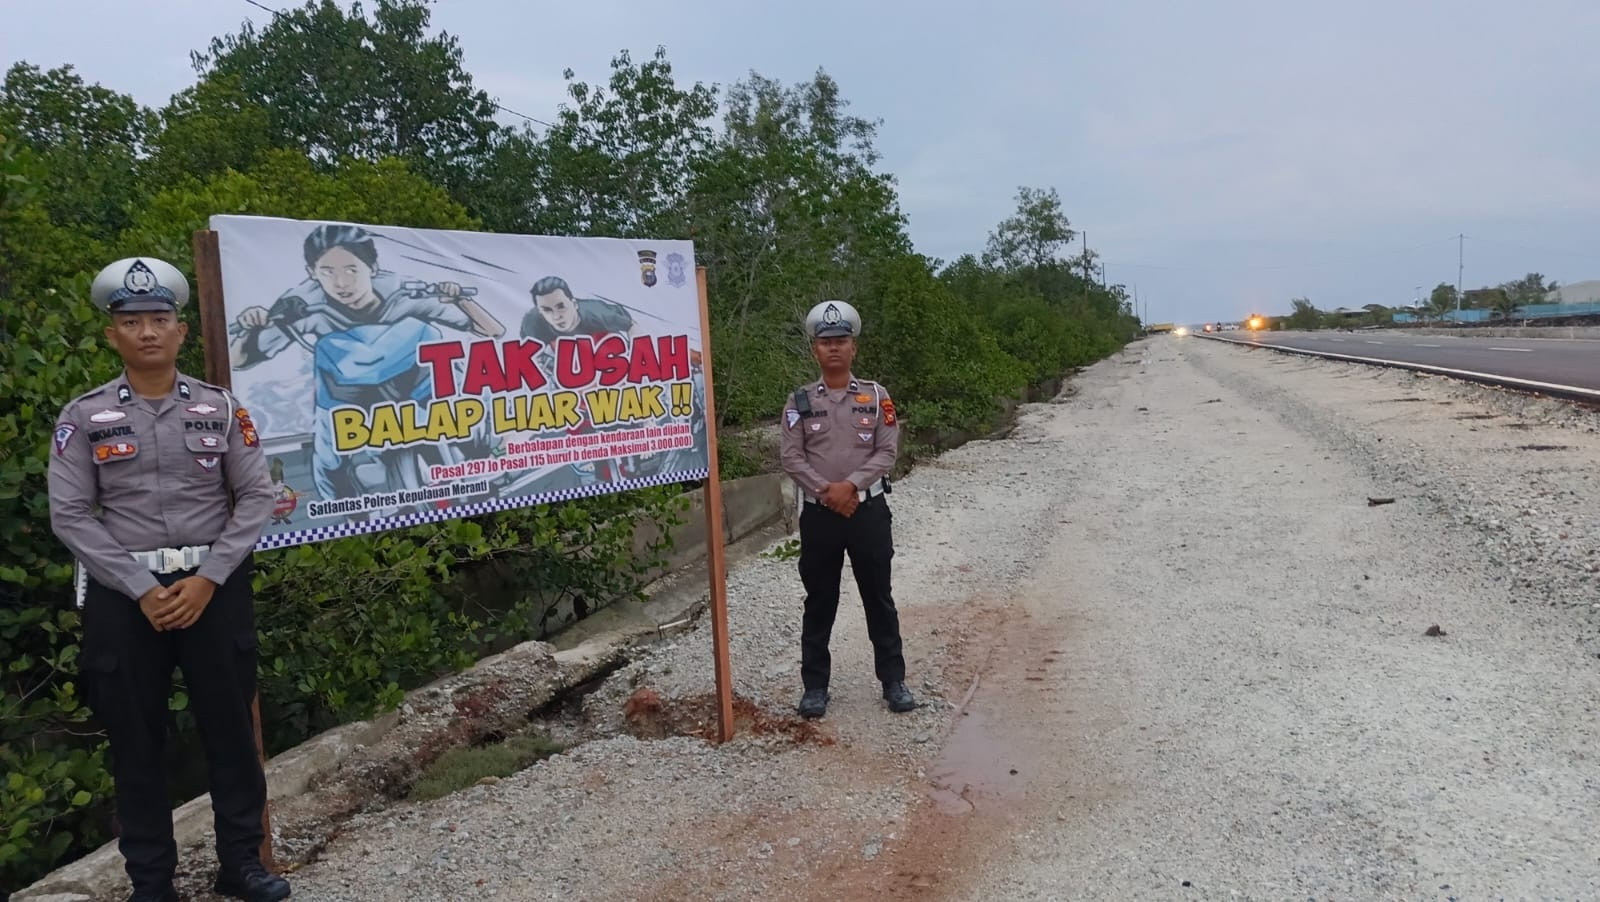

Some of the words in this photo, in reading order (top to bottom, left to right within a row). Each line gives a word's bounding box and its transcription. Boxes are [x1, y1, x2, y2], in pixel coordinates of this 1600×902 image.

[419, 340, 546, 399] TAK
[556, 335, 690, 388] USAH
[185, 420, 224, 432] POLRI
[332, 398, 484, 450] BALAP
[493, 391, 581, 434] LIAR
[585, 385, 666, 425] WAK
[670, 382, 692, 416] !!
[431, 463, 464, 480] (Pasal
[467, 461, 485, 475] 297
[500, 455, 527, 471] Pasal
[530, 453, 545, 467] 115
[546, 450, 571, 465] huruf
[573, 449, 580, 461] b
[581, 446, 608, 460] denda
[610, 441, 649, 456] Maksimal
[651, 435, 692, 450] 3.000.000)
[508, 438, 564, 455] Berbalapan
[566, 434, 599, 448] dengan
[600, 429, 645, 443] kendaraan
[646, 427, 661, 438] lain
[663, 424, 690, 437] dijalan
[309, 498, 363, 517] Satlantas
[364, 493, 397, 509] Polres
[399, 487, 451, 506] Kepulauan
[452, 480, 488, 495] Meranti
